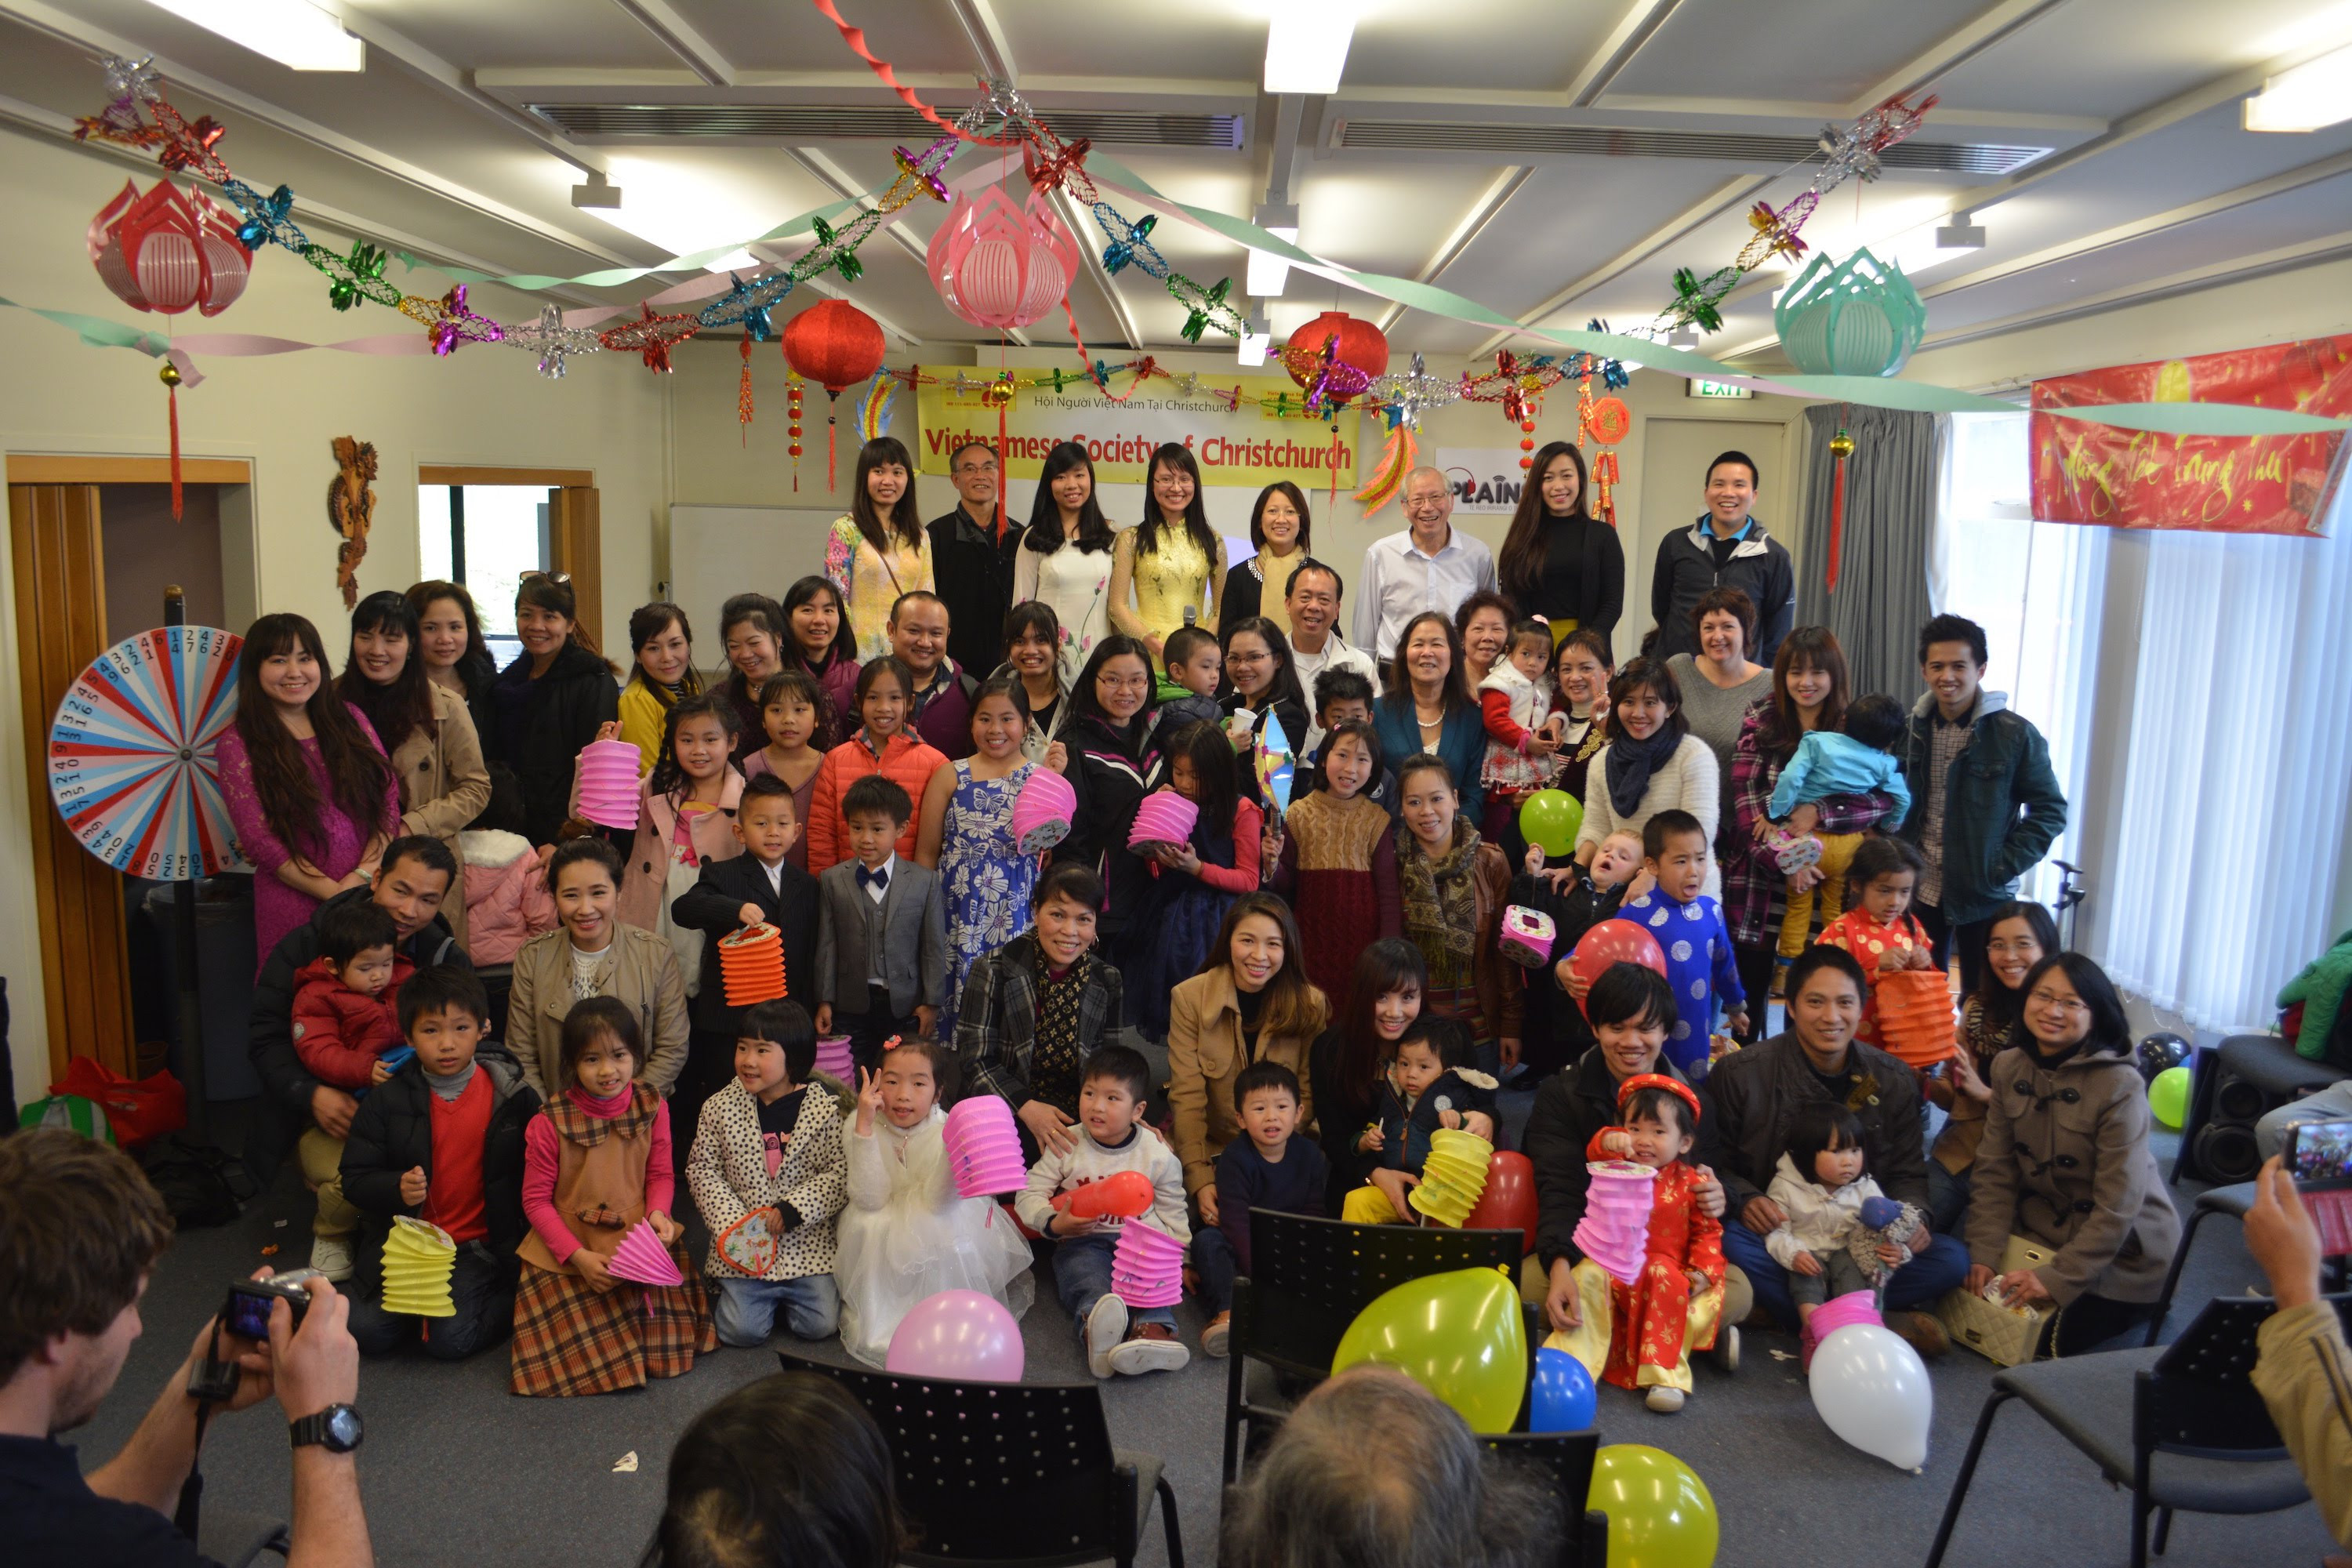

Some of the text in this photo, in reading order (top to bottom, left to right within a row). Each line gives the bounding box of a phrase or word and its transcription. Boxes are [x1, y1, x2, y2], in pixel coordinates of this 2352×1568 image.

[1035, 396, 1054, 409] Hội
[1118, 398, 1145, 409] Nam
[1147, 399, 1163, 412] Tại
[1201, 437, 1351, 469] Christchurch
[1453, 481, 1523, 504] PLAIN
